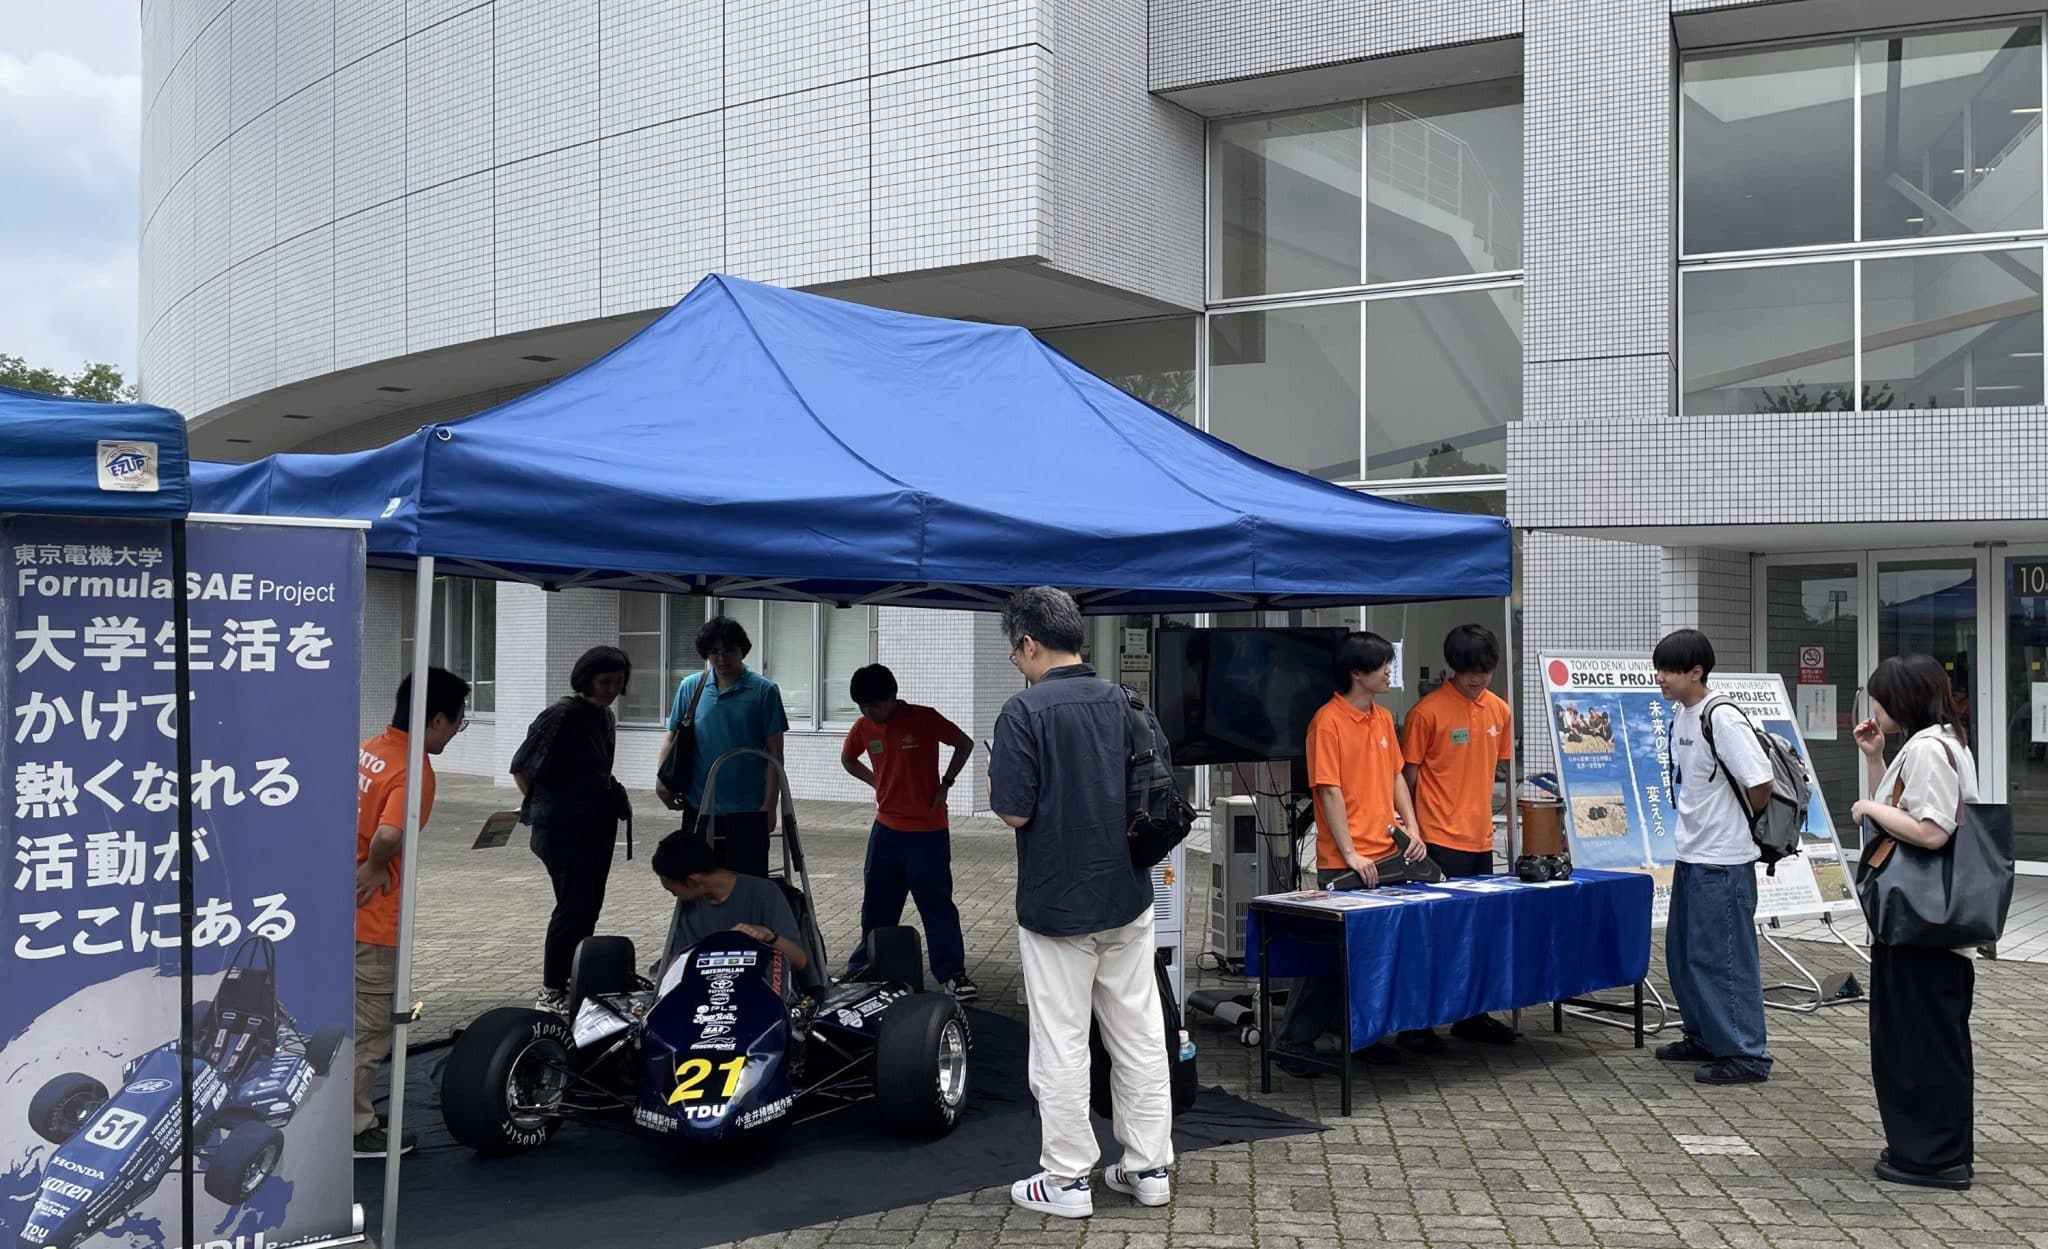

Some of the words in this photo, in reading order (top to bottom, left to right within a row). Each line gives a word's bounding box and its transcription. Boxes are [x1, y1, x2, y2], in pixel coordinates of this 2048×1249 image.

[13, 544, 163, 568] 東京電機大学
[19, 568, 174, 599] Formula
[185, 573, 254, 601] SAE
[260, 580, 336, 607] Project
[2021, 566, 2048, 593] 10
[15, 615, 334, 673] 大学生活を
[1570, 660, 1599, 671] TOKYO
[1600, 660, 1626, 671] DENKI
[1571, 672, 1615, 686] SPACE
[1729, 691, 1777, 702] PROJECT
[15, 689, 196, 743] かけて
[15, 757, 299, 819] 熱くなれる
[1646, 785, 1665, 837] 変える
[14, 827, 210, 891] 活動が
[14, 893, 296, 960] ここにある
[667, 1056, 746, 1106] 21
[94, 1113, 140, 1146] 51
[684, 1104, 728, 1120] TDU
[51, 1156, 105, 1180] HONDA
